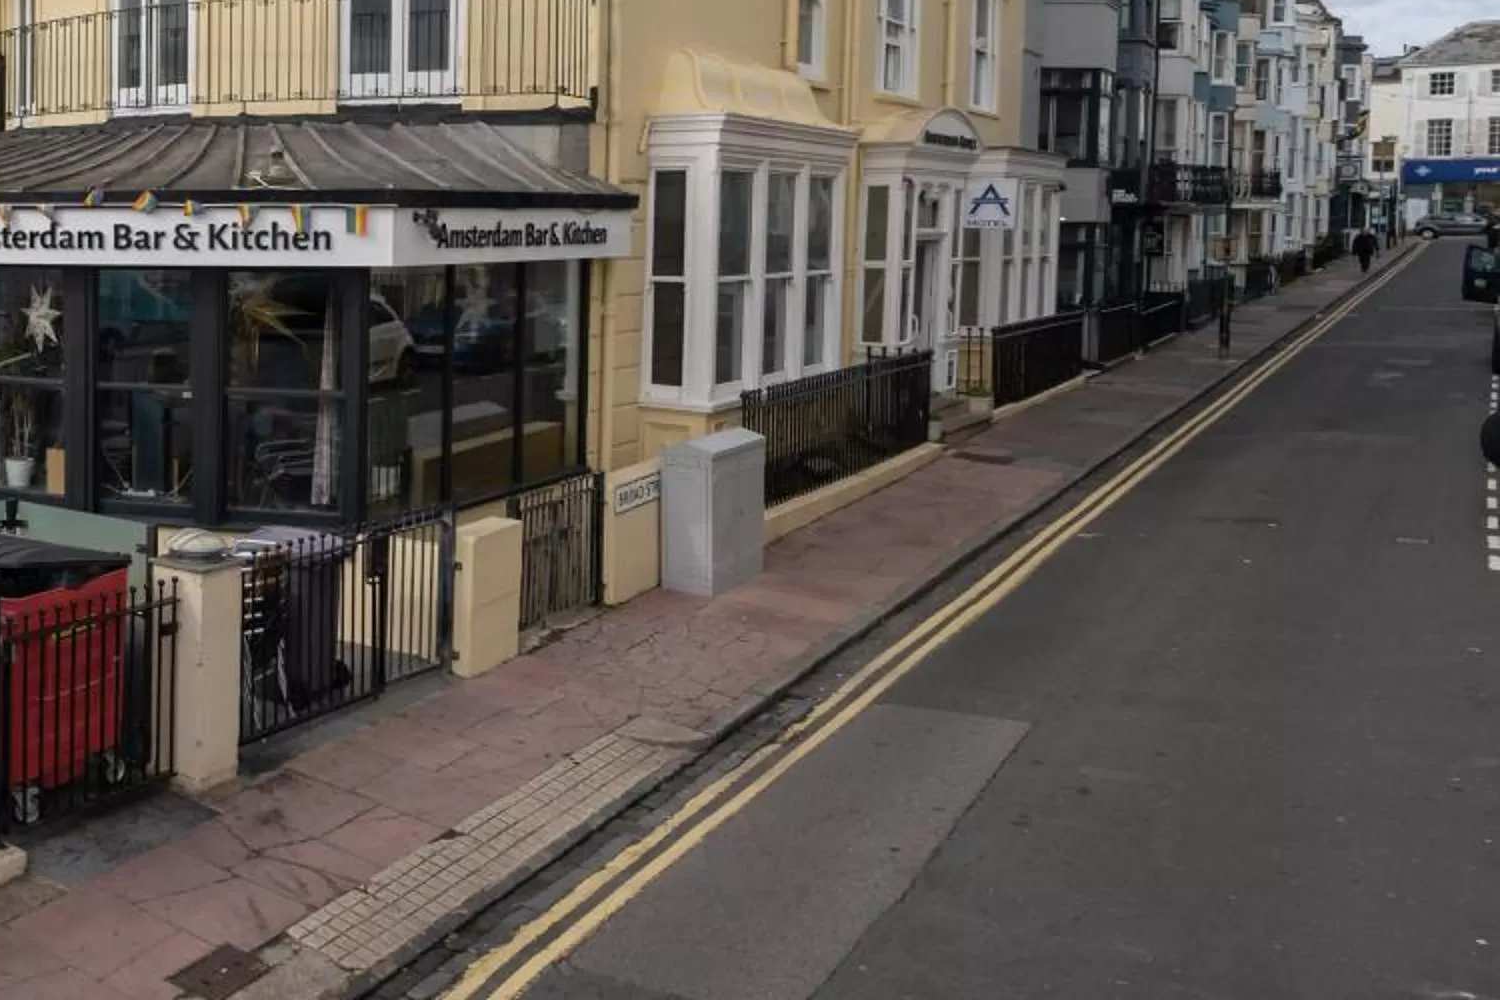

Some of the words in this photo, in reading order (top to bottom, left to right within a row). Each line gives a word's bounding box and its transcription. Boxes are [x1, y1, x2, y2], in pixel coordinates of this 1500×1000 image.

[113, 223, 166, 251] Bar
[173, 223, 199, 251] &
[208, 222, 332, 251] Kitchen
[437, 220, 522, 249] Amsterdam
[525, 222, 548, 247] Bar
[550, 221, 562, 247] &
[563, 220, 607, 245] Kitchen
